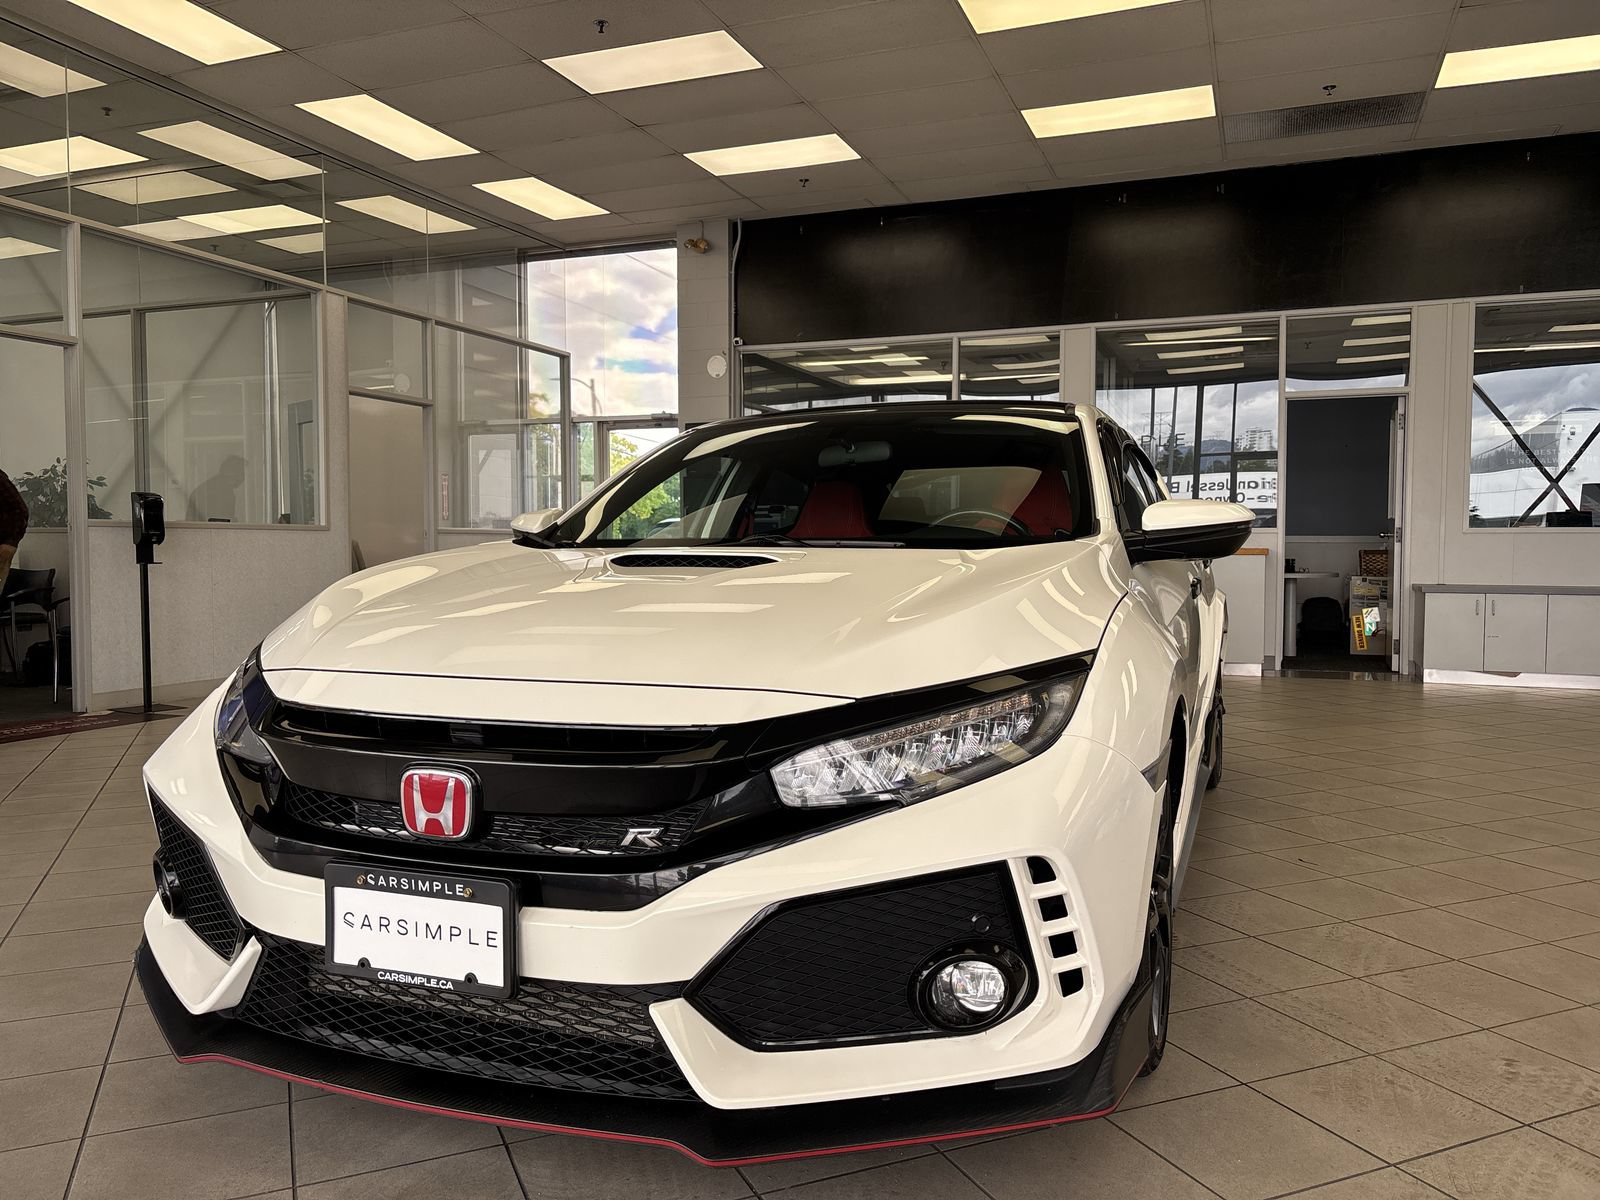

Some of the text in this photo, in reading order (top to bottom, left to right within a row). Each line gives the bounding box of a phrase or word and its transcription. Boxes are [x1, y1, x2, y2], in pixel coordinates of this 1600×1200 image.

[620, 827, 665, 848] R
[367, 873, 464, 896] CARSIMPLE
[343, 911, 498, 948] CARSIMPLE
[377, 971, 454, 991] CARSIMPLE.CA
